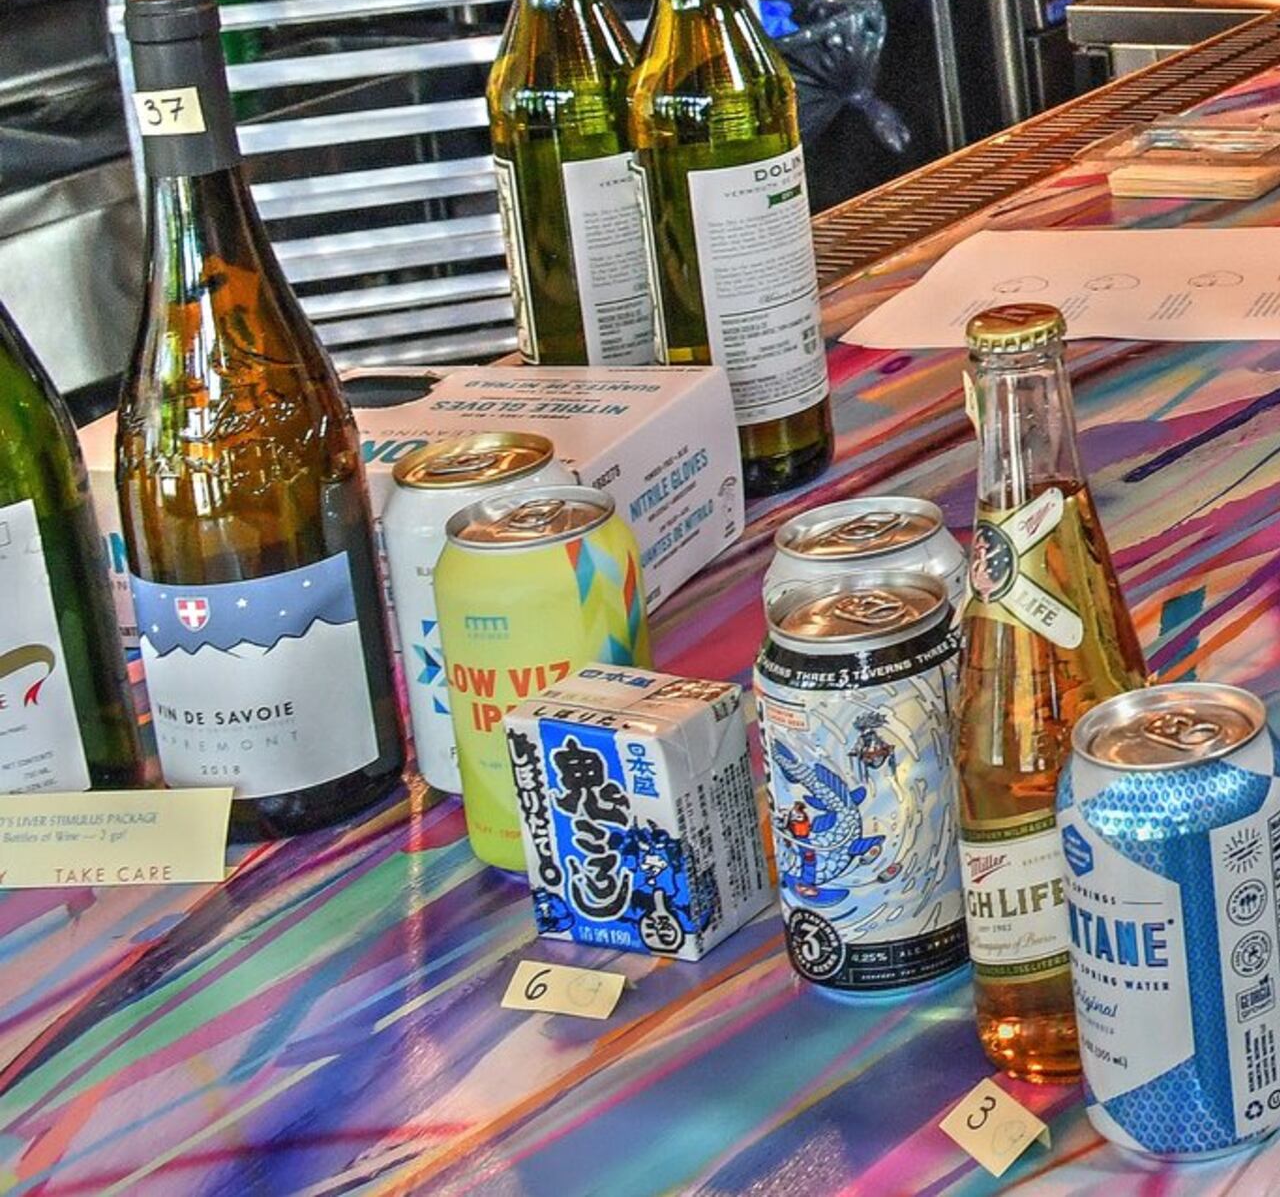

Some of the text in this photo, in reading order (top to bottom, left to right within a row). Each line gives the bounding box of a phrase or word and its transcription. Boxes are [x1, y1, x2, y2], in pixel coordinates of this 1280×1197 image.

[143, 97, 185, 126] 37
[754, 156, 802, 182] DOLIN
[429, 400, 631, 415] NITRILE GLOVES
[628, 475, 670, 523] NITRILE
[670, 448, 710, 493] GLOVES
[449, 663, 497, 699] OW
[796, 671, 836, 683] THREE
[157, 702, 294, 725] VIN DE SAVOIE
[472, 702, 519, 733] IP
[201, 764, 242, 776] 2018
[17, 814, 48, 826] LIVER
[50, 813, 105, 825] STIMULUS
[106, 812, 159, 825] PACKAGE
[56, 865, 172, 884] TAKE CARE
[967, 877, 1065, 918] GH LIFE
[801, 922, 820, 961] 3
[524, 969, 552, 1001] 6
[1124, 980, 1170, 991] WATER
[966, 1096, 996, 1130] 3
